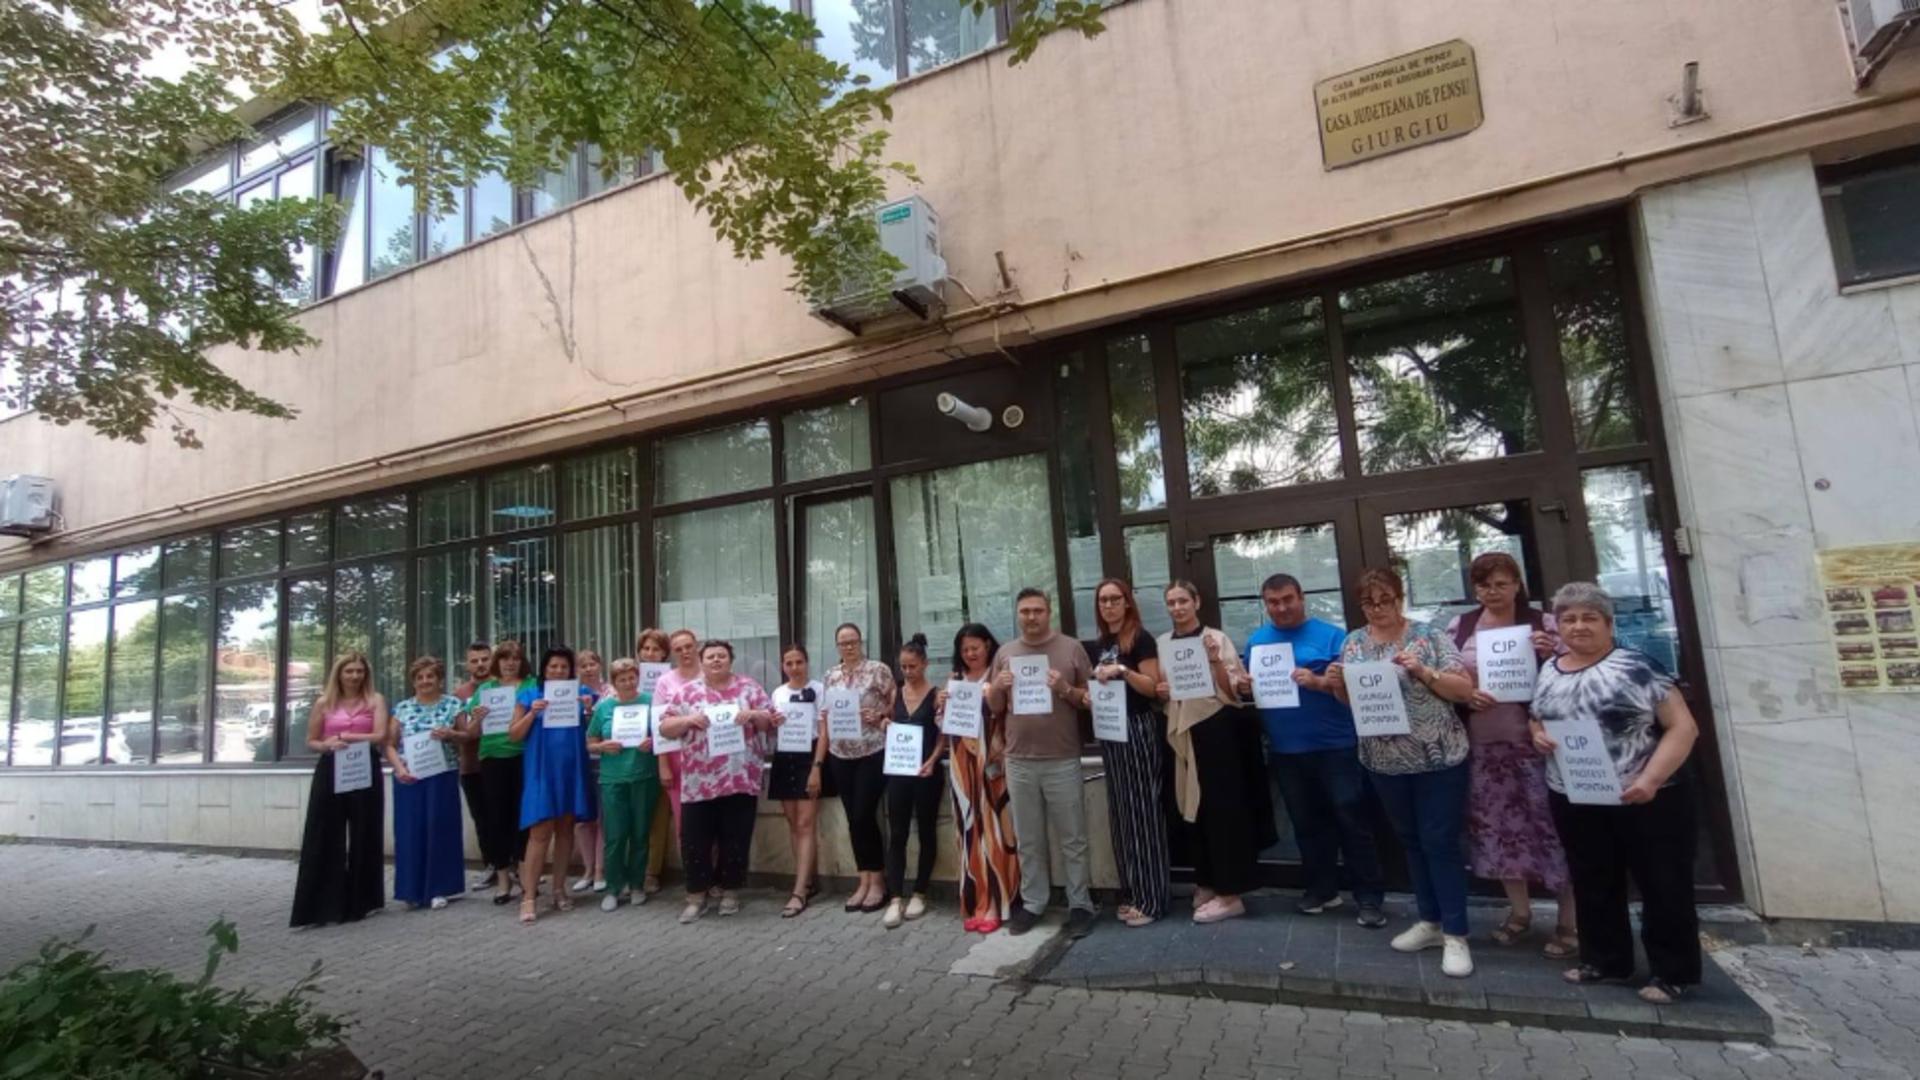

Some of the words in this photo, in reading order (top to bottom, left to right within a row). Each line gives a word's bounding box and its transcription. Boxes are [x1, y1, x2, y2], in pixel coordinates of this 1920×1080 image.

[1408, 59, 1420, 70] DE
[1325, 113, 1353, 133] CASA
[1416, 88, 1432, 108] DE
[1351, 113, 1450, 155] GIURGIU
[1491, 639, 1518, 654] CJP
[1174, 647, 1195, 661] CJP
[1260, 653, 1283, 668] CJP
[1020, 665, 1041, 677] CJP
[1488, 669, 1528, 679] PROTEST
[1359, 674, 1383, 688] CJP
[1564, 735, 1589, 750] CJP
